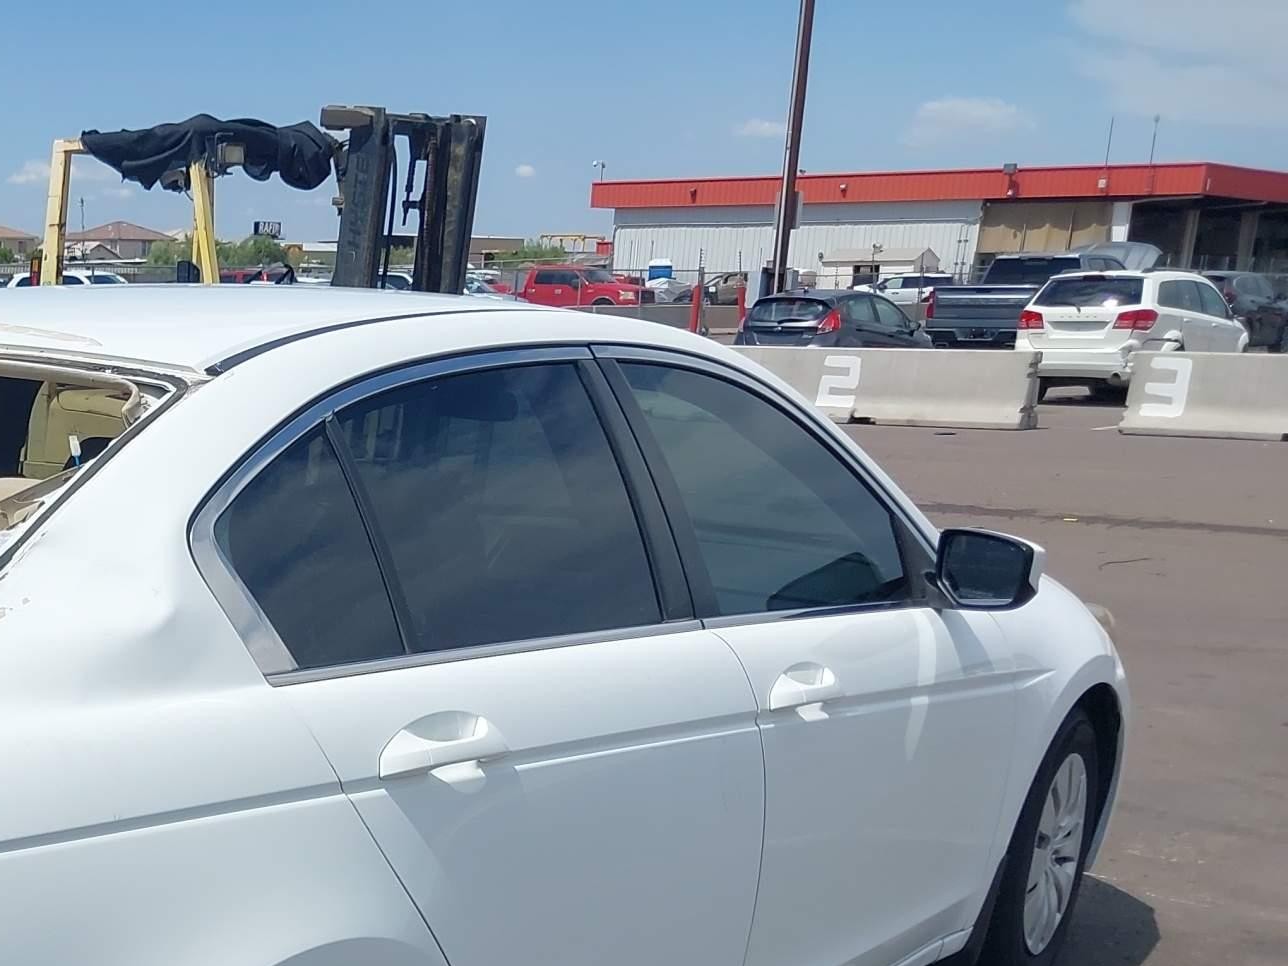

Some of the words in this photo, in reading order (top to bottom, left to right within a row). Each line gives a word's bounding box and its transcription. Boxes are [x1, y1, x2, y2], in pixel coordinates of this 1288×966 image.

[347, 155, 369, 250] HYSTE
[814, 354, 862, 408] 2
[1138, 356, 1193, 417] 3
